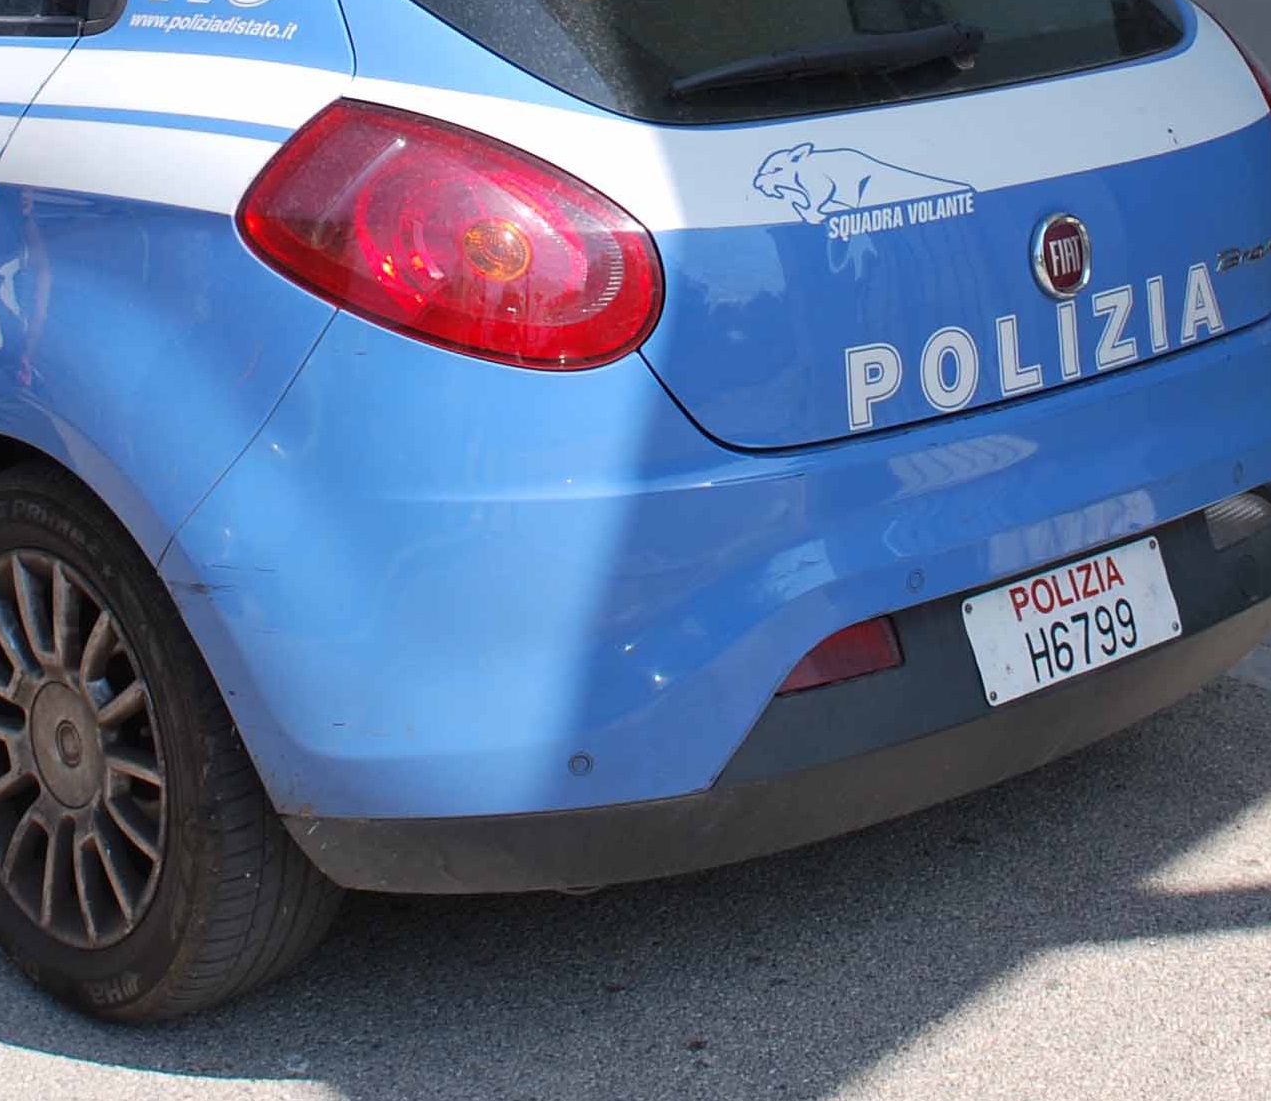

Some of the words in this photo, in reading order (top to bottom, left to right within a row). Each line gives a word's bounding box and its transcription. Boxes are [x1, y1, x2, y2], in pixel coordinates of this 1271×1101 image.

[128, 11, 299, 42] www.poliziadistato.it
[828, 206, 904, 242] SQUADRA
[906, 191, 975, 227] VOLANTE
[1048, 236, 1084, 278] FIAT
[843, 260, 1226, 432] POLIZIA
[1008, 555, 1126, 622] POLIZIA
[1024, 597, 1139, 684] H6799
